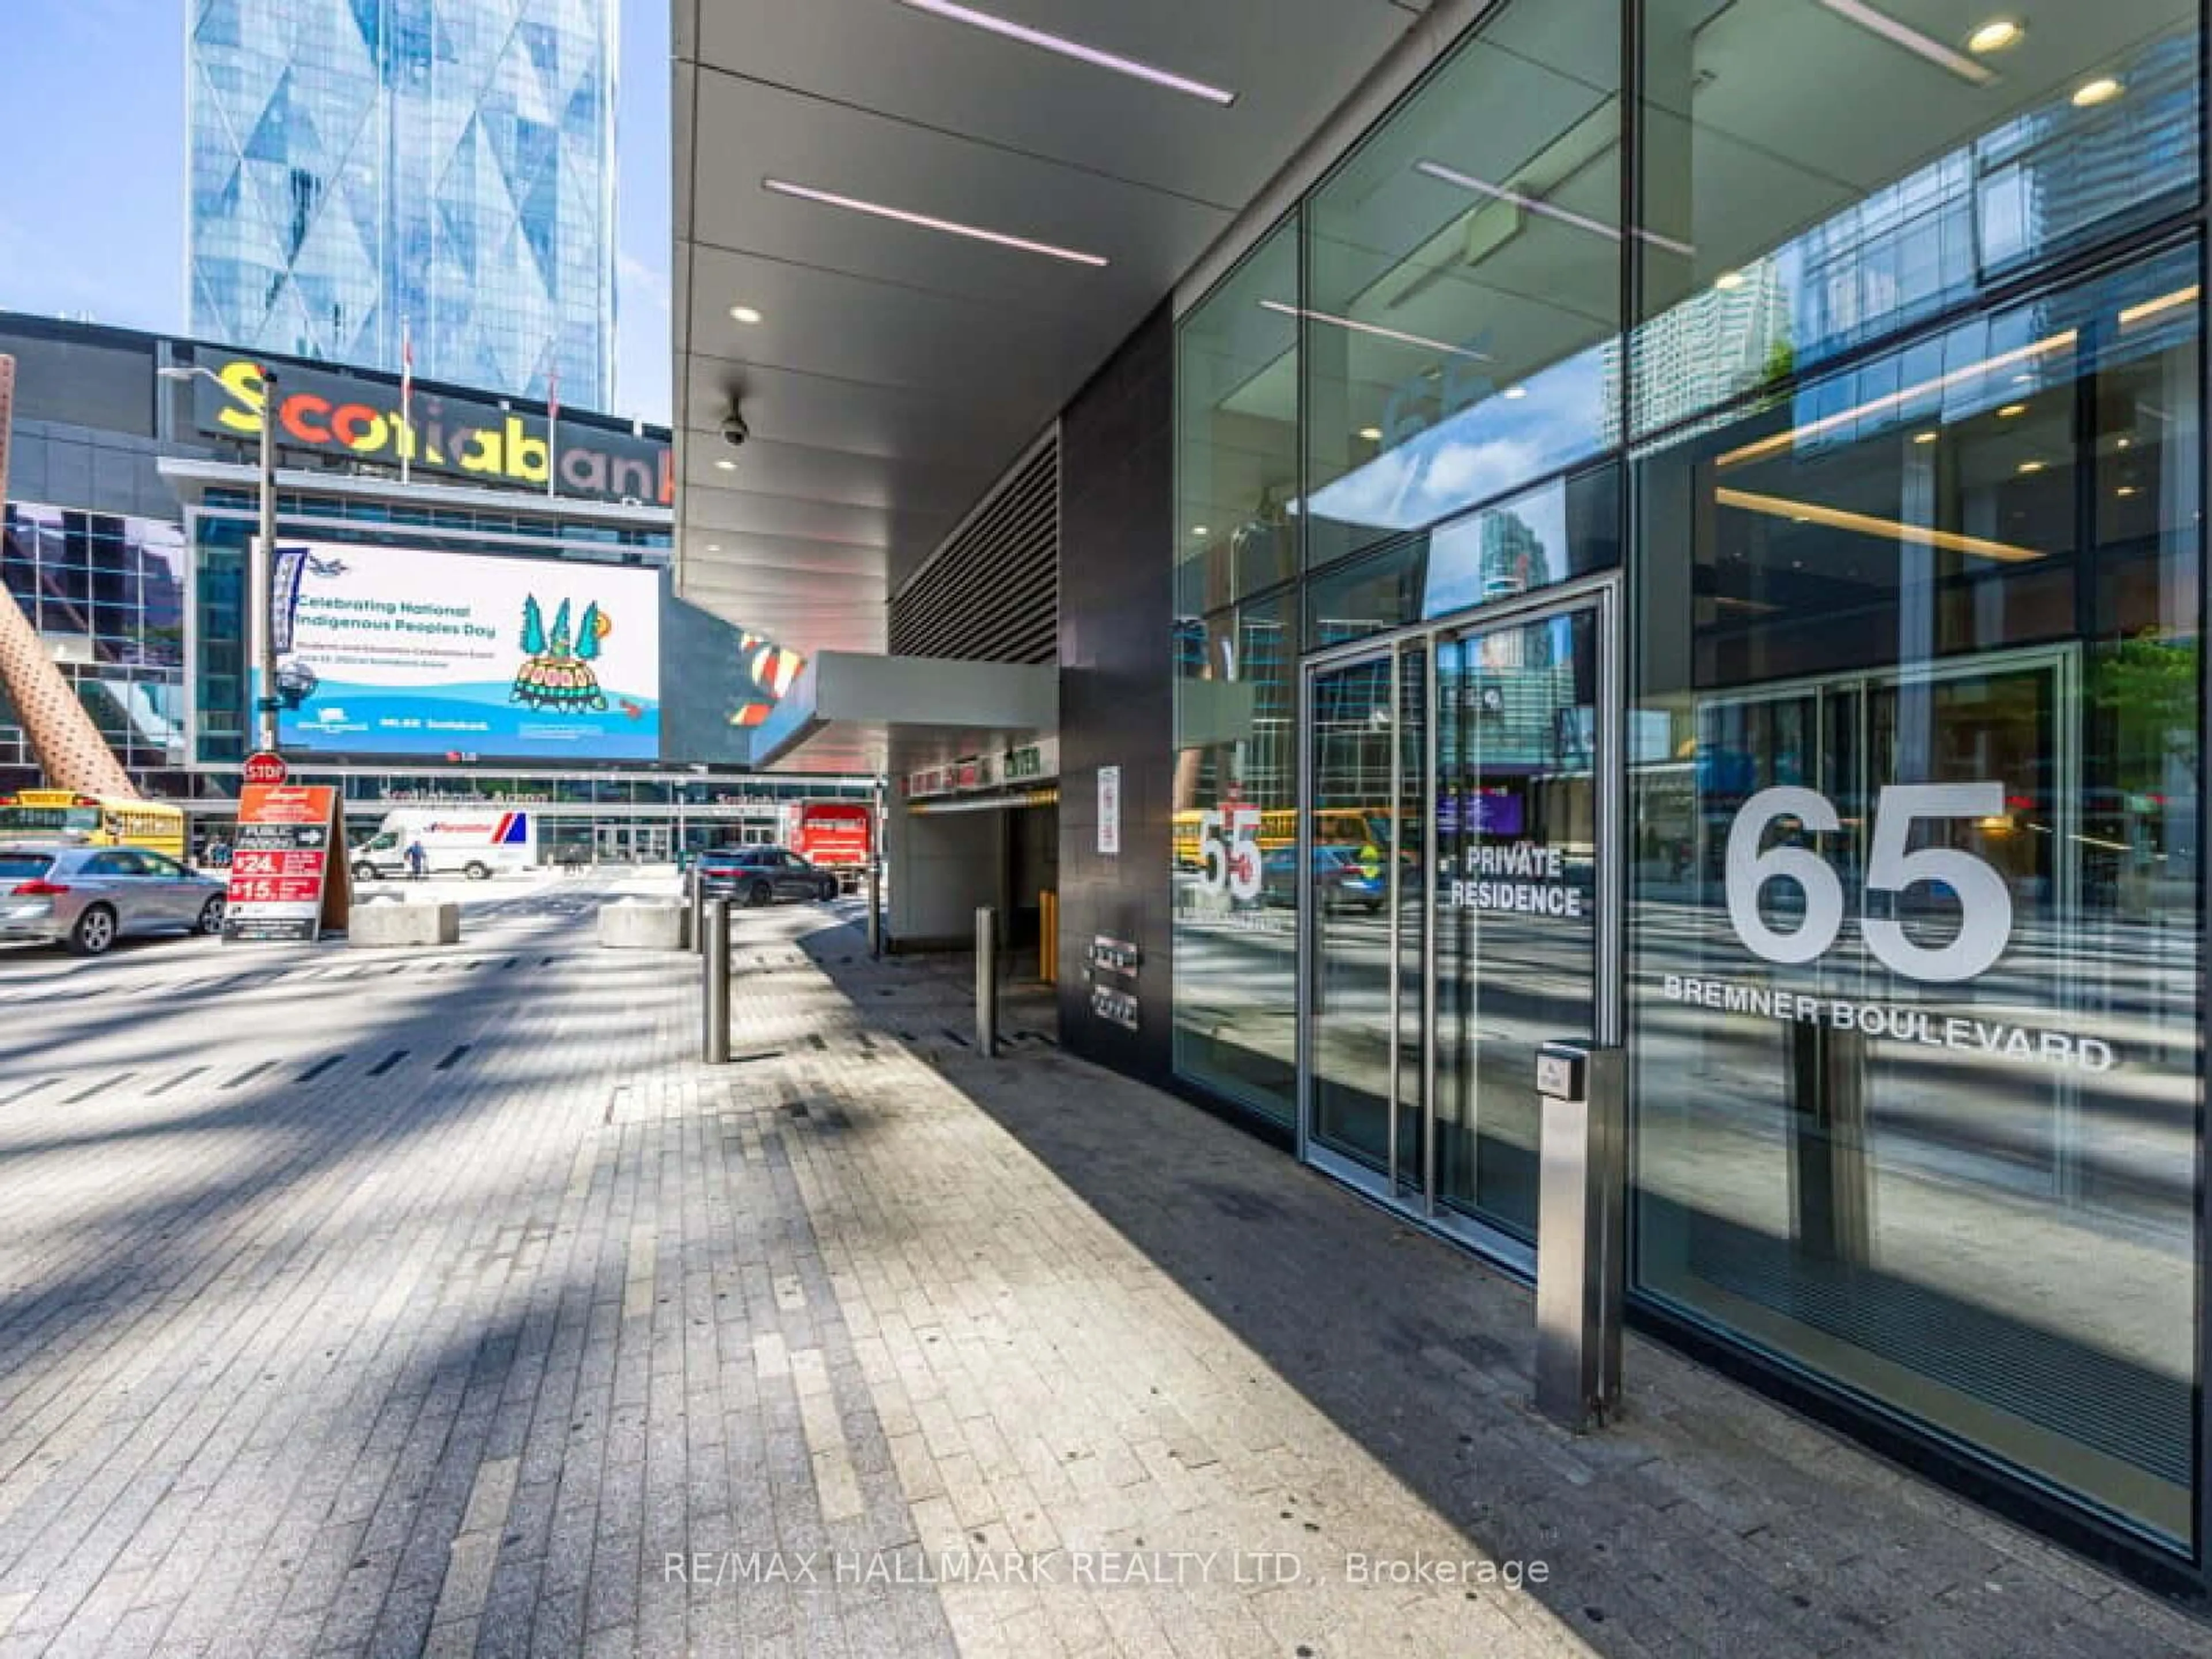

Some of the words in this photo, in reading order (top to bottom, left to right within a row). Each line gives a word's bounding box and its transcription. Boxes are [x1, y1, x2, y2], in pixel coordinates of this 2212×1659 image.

[298, 594, 396, 615] Celebrating
[401, 601, 471, 618] National
[395, 619, 460, 635] Peoples
[464, 623, 497, 639] Day
[248, 764, 283, 780] STOP
[1467, 845, 1561, 877] PRIVATE
[1451, 880, 1581, 916] RESIDENCE
[1729, 782, 2012, 983] 65
[1662, 974, 1819, 1025] BREMNER
[1832, 999, 2114, 1073] BOULEVARD
